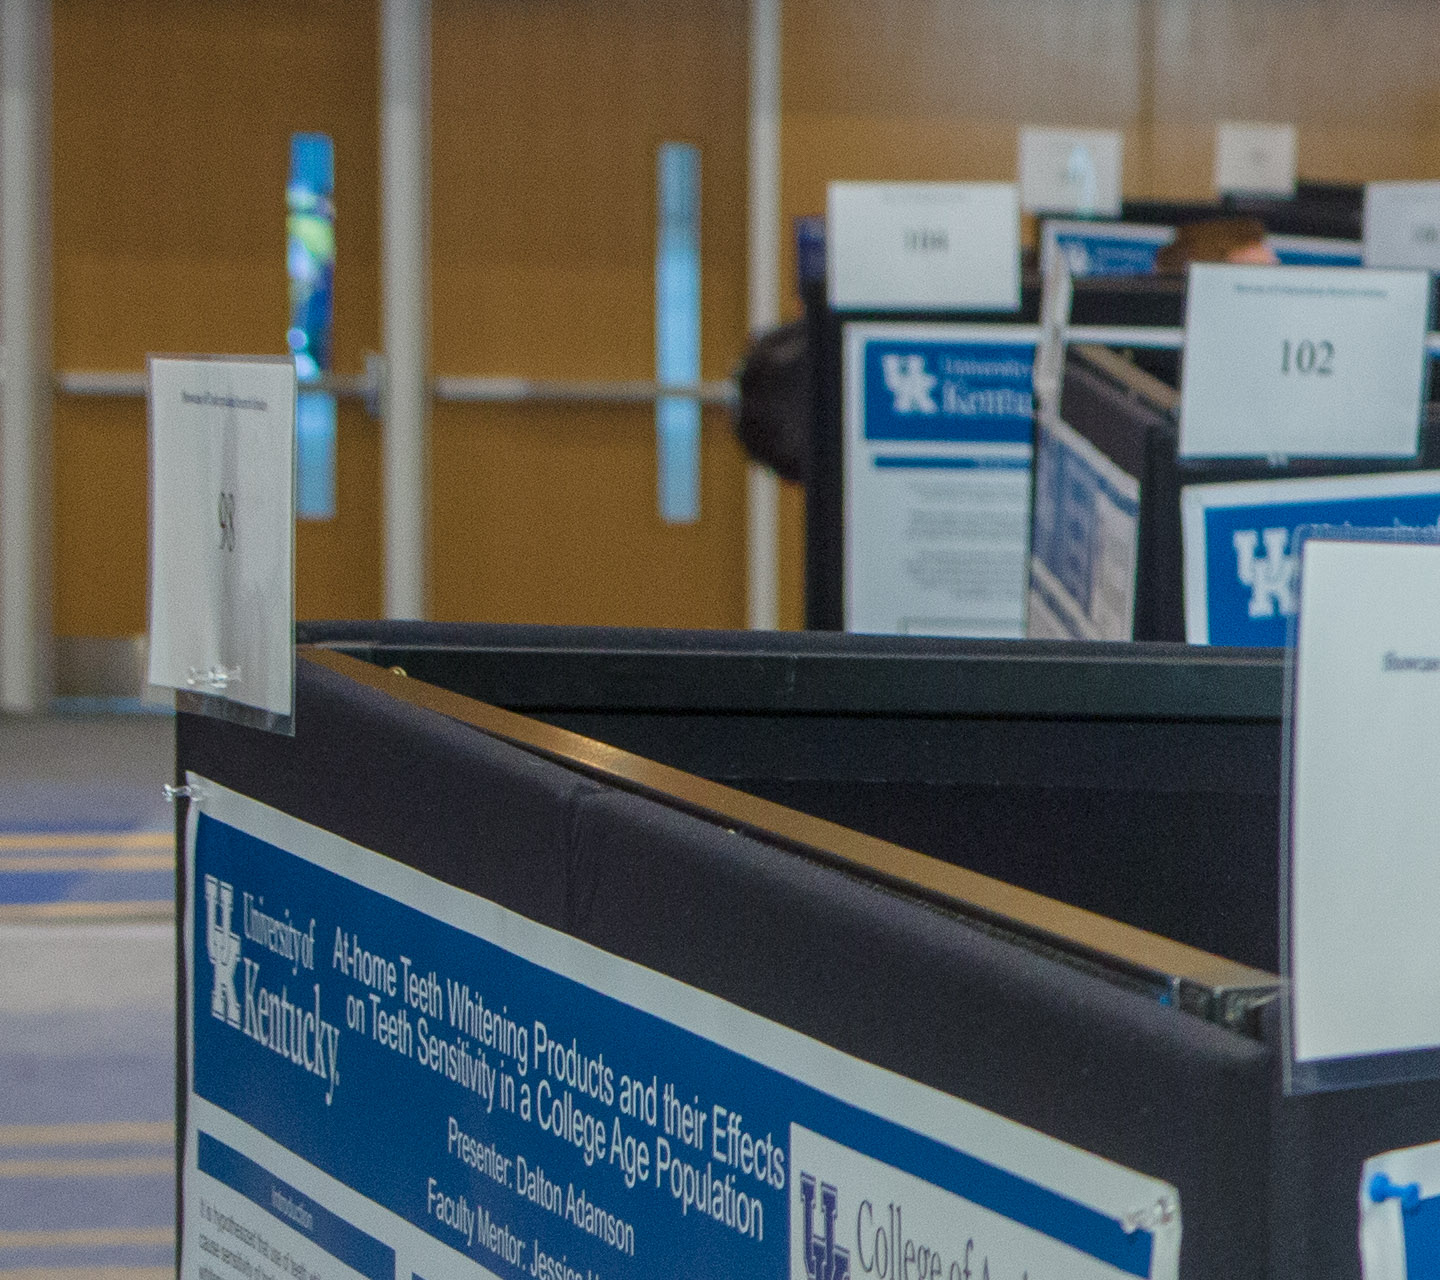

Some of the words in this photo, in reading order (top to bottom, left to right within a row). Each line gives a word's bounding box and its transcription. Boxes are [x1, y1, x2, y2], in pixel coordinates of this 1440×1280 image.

[1281, 338, 1335, 376] 102
[242, 891, 301, 977] University
[298, 918, 317, 971] of
[332, 925, 397, 998] At-home
[399, 954, 444, 1021] Teeth
[446, 977, 529, 1071] Whitening
[533, 1019, 615, 1107] Products
[618, 1074, 658, 1127] and
[662, 1082, 708, 1151] their
[711, 1103, 786, 1191] Effects
[345, 994, 366, 1035] on
[368, 992, 413, 1059] Teeth
[416, 1016, 497, 1114] Sensitivity
[499, 1072, 516, 1114] in
[517, 1076, 533, 1124] a
[536, 1078, 607, 1167] College
[609, 1115, 651, 1189] Age
[655, 1135, 764, 1242] Population
[427, 1176, 476, 1247] Faculty
[476, 1204, 527, 1268] Mentor:
[447, 1115, 513, 1186] Presenter:
[516, 1154, 563, 1217] Dalton
[564, 1182, 635, 1257] Adamson
